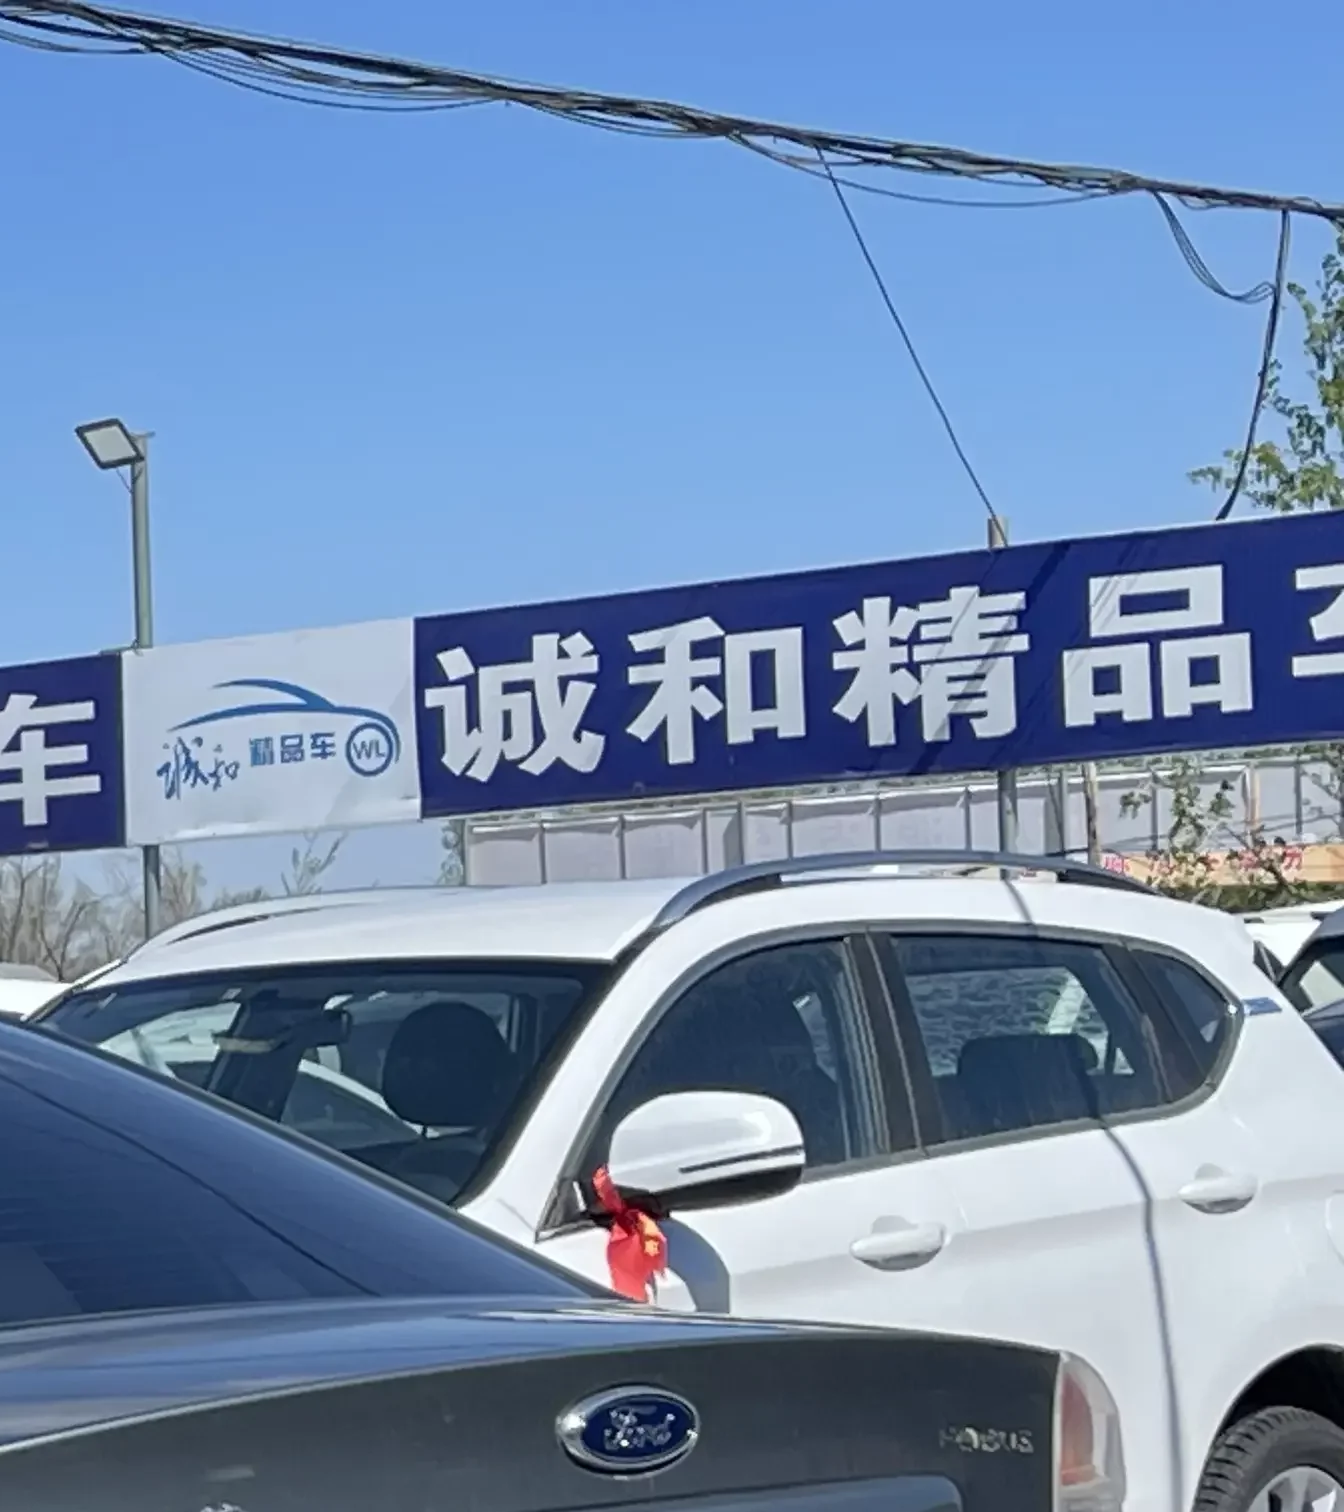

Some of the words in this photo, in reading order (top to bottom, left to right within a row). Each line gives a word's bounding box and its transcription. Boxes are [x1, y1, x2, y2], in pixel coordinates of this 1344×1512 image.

[425, 563, 1344, 782] 诚和精品
[248, 731, 337, 767] 精品车
